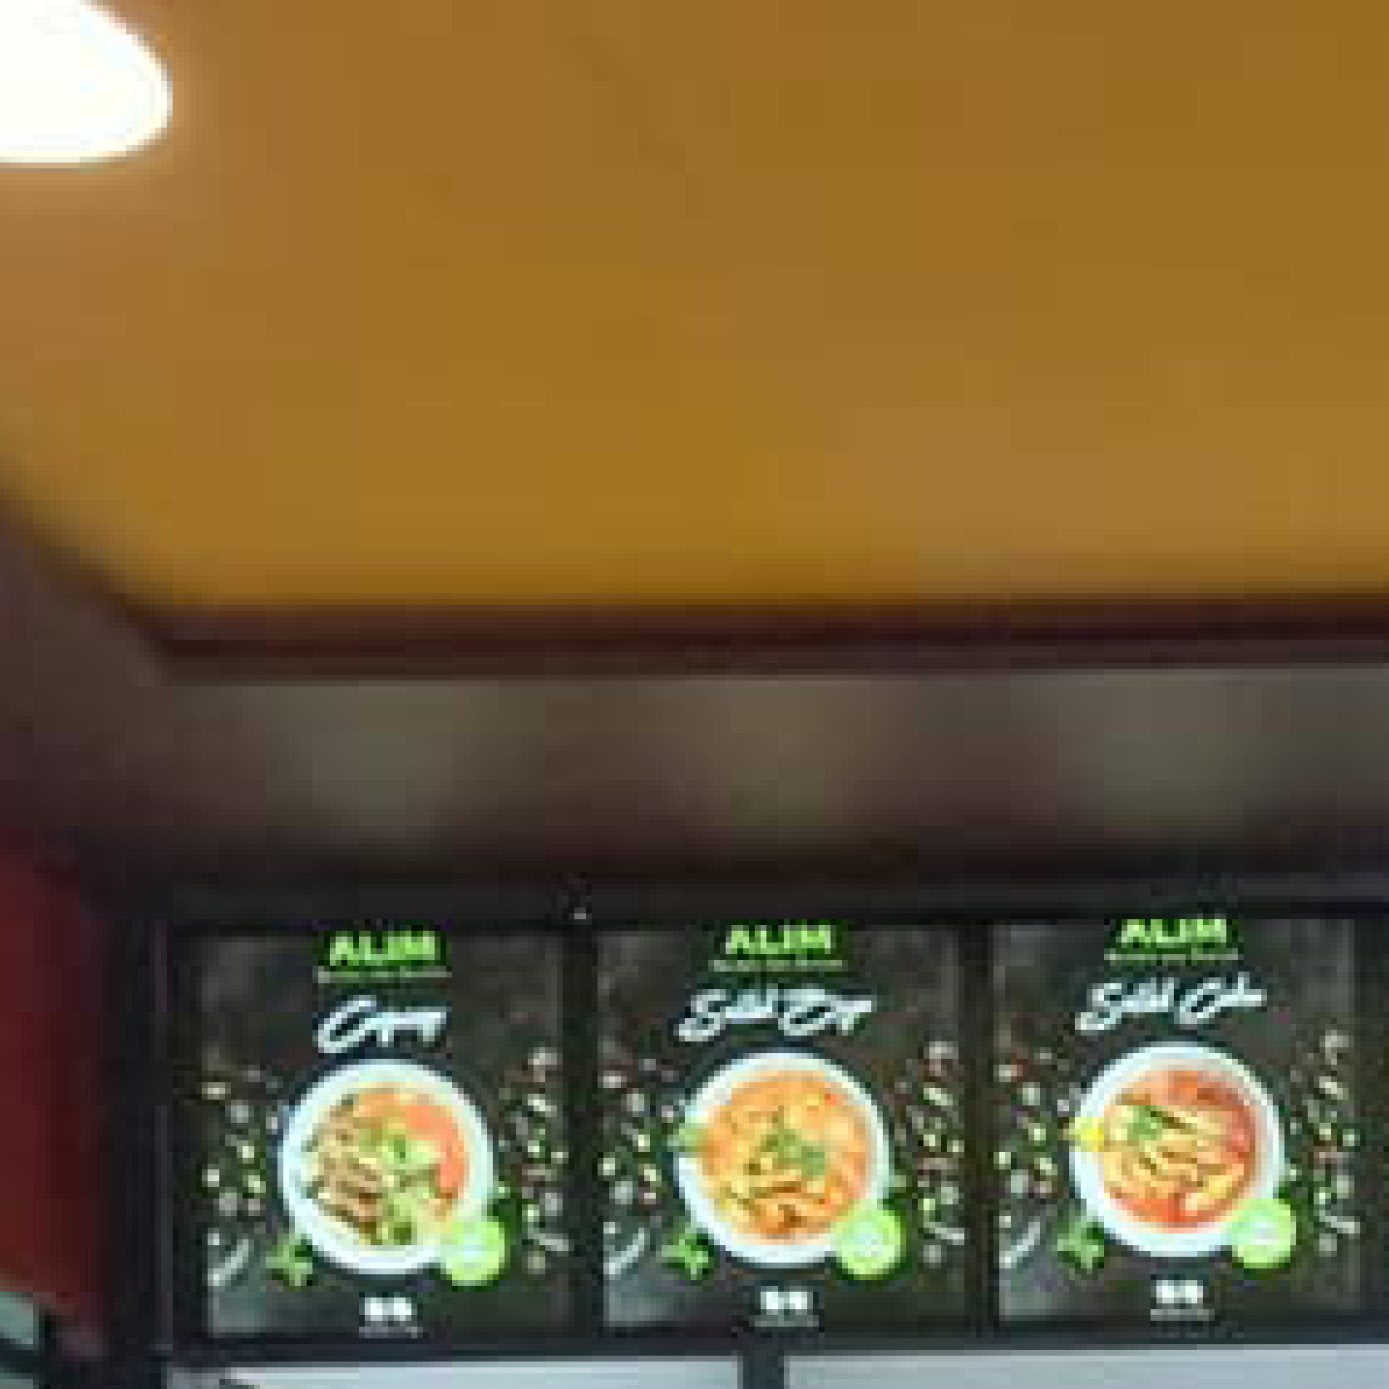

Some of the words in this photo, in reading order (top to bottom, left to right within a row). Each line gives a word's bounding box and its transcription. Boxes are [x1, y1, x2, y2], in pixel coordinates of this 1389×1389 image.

[328, 931, 438, 967] ALIM
[724, 924, 833, 956] ALIM
[1118, 918, 1227, 949] ALIM
